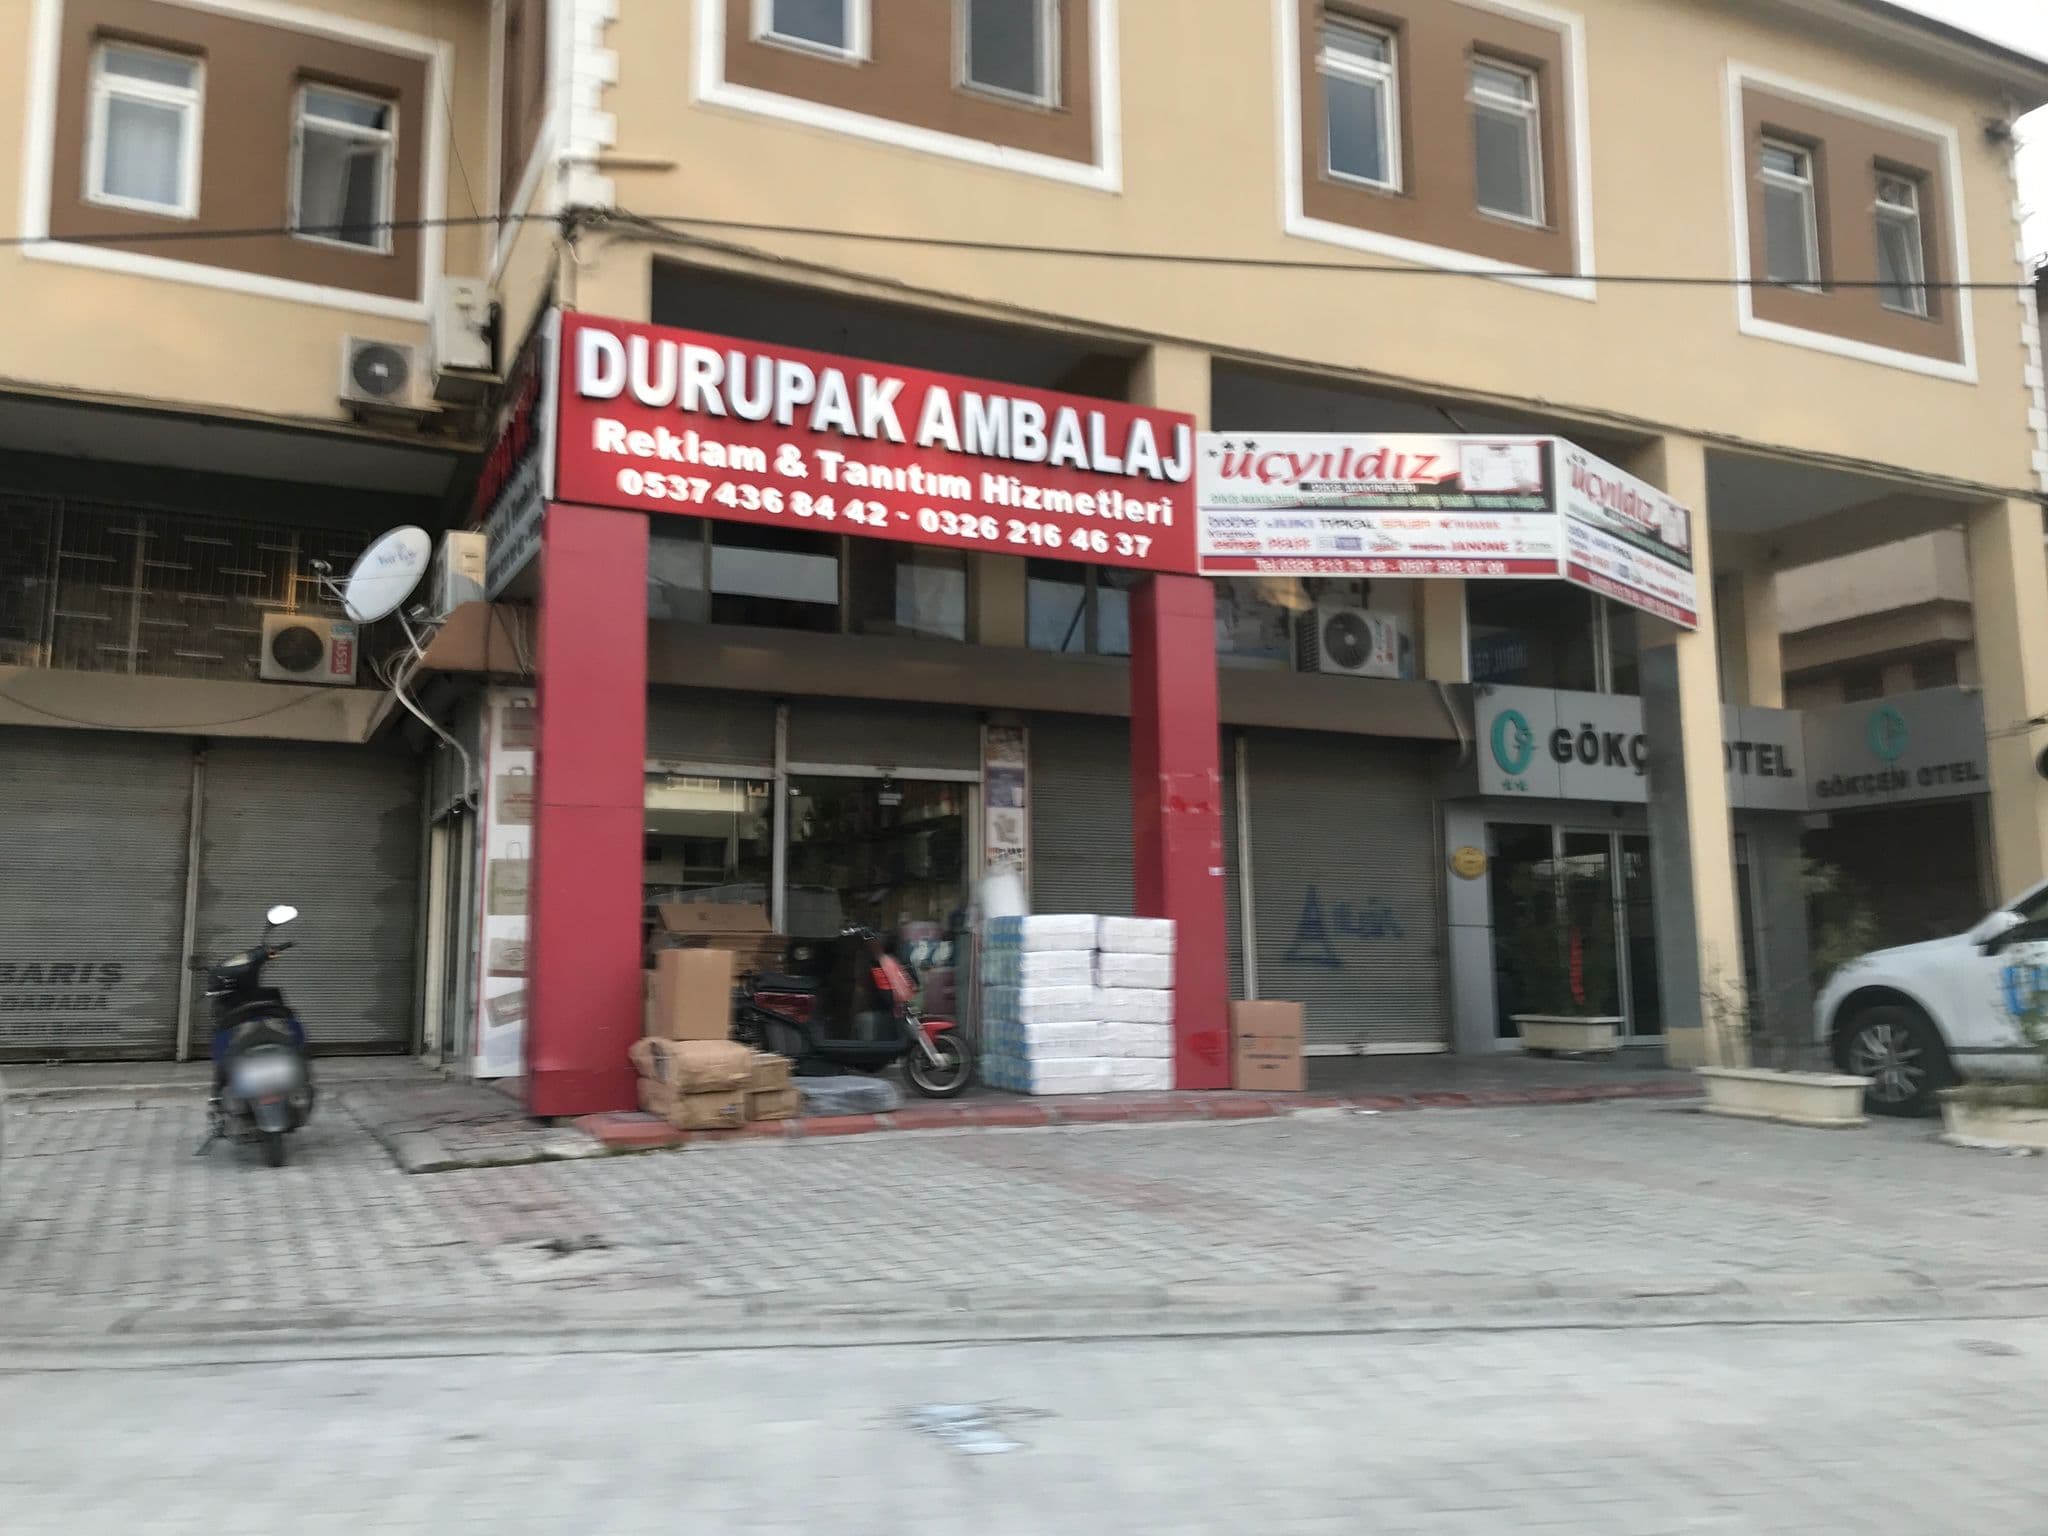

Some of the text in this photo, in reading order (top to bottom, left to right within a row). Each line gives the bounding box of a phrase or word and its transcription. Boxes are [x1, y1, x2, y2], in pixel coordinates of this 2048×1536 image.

[575, 326, 906, 444] DURUPAK
[915, 384, 1192, 484] AMBALAJ
[592, 417, 1174, 526] Reklam & Tanıtım Hizmetleri
[616, 467, 711, 504] 0537
[713, 481, 785, 514] 436
[788, 490, 837, 521] 84
[841, 498, 889, 527] 42
[917, 506, 1000, 541] 0326
[1005, 519, 1063, 548] 216
[1068, 528, 1110, 553] 46
[1115, 532, 1153, 558] 37
[1723, 741, 1793, 778] TEL
[1917, 760, 1981, 787] OTEL
